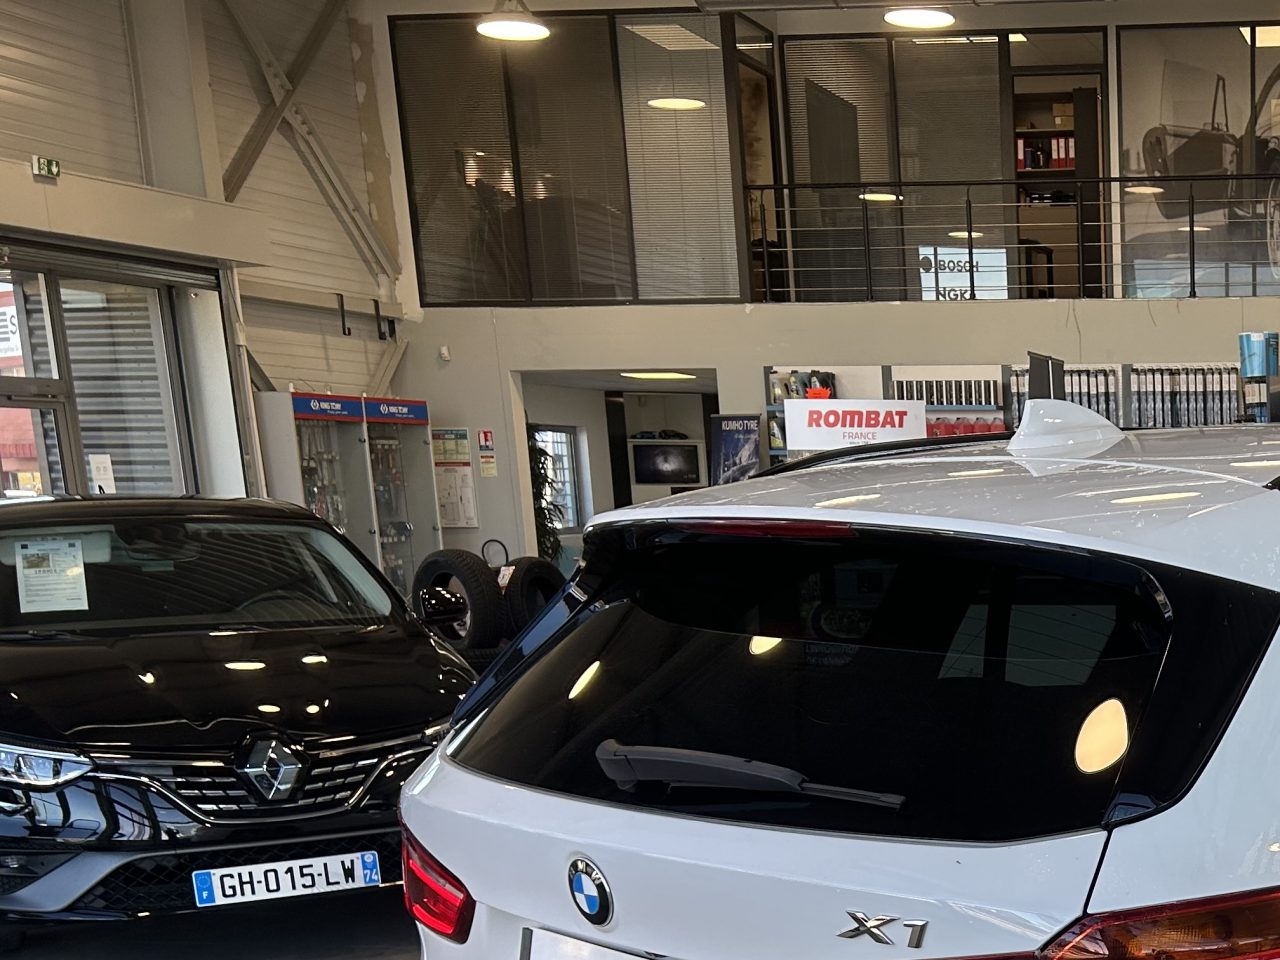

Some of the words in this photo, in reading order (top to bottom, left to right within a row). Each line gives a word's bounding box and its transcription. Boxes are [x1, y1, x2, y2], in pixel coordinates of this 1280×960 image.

[938, 259, 979, 272] BOSCH
[722, 420, 743, 430] KUMHO
[744, 420, 758, 430] TYRE
[807, 410, 908, 428] ROMBAT
[842, 432, 877, 440] FRANCE
[202, 891, 208, 900] F
[219, 859, 356, 899] GH-015-LW
[364, 869, 378, 883] 74
[836, 909, 929, 949] X1
